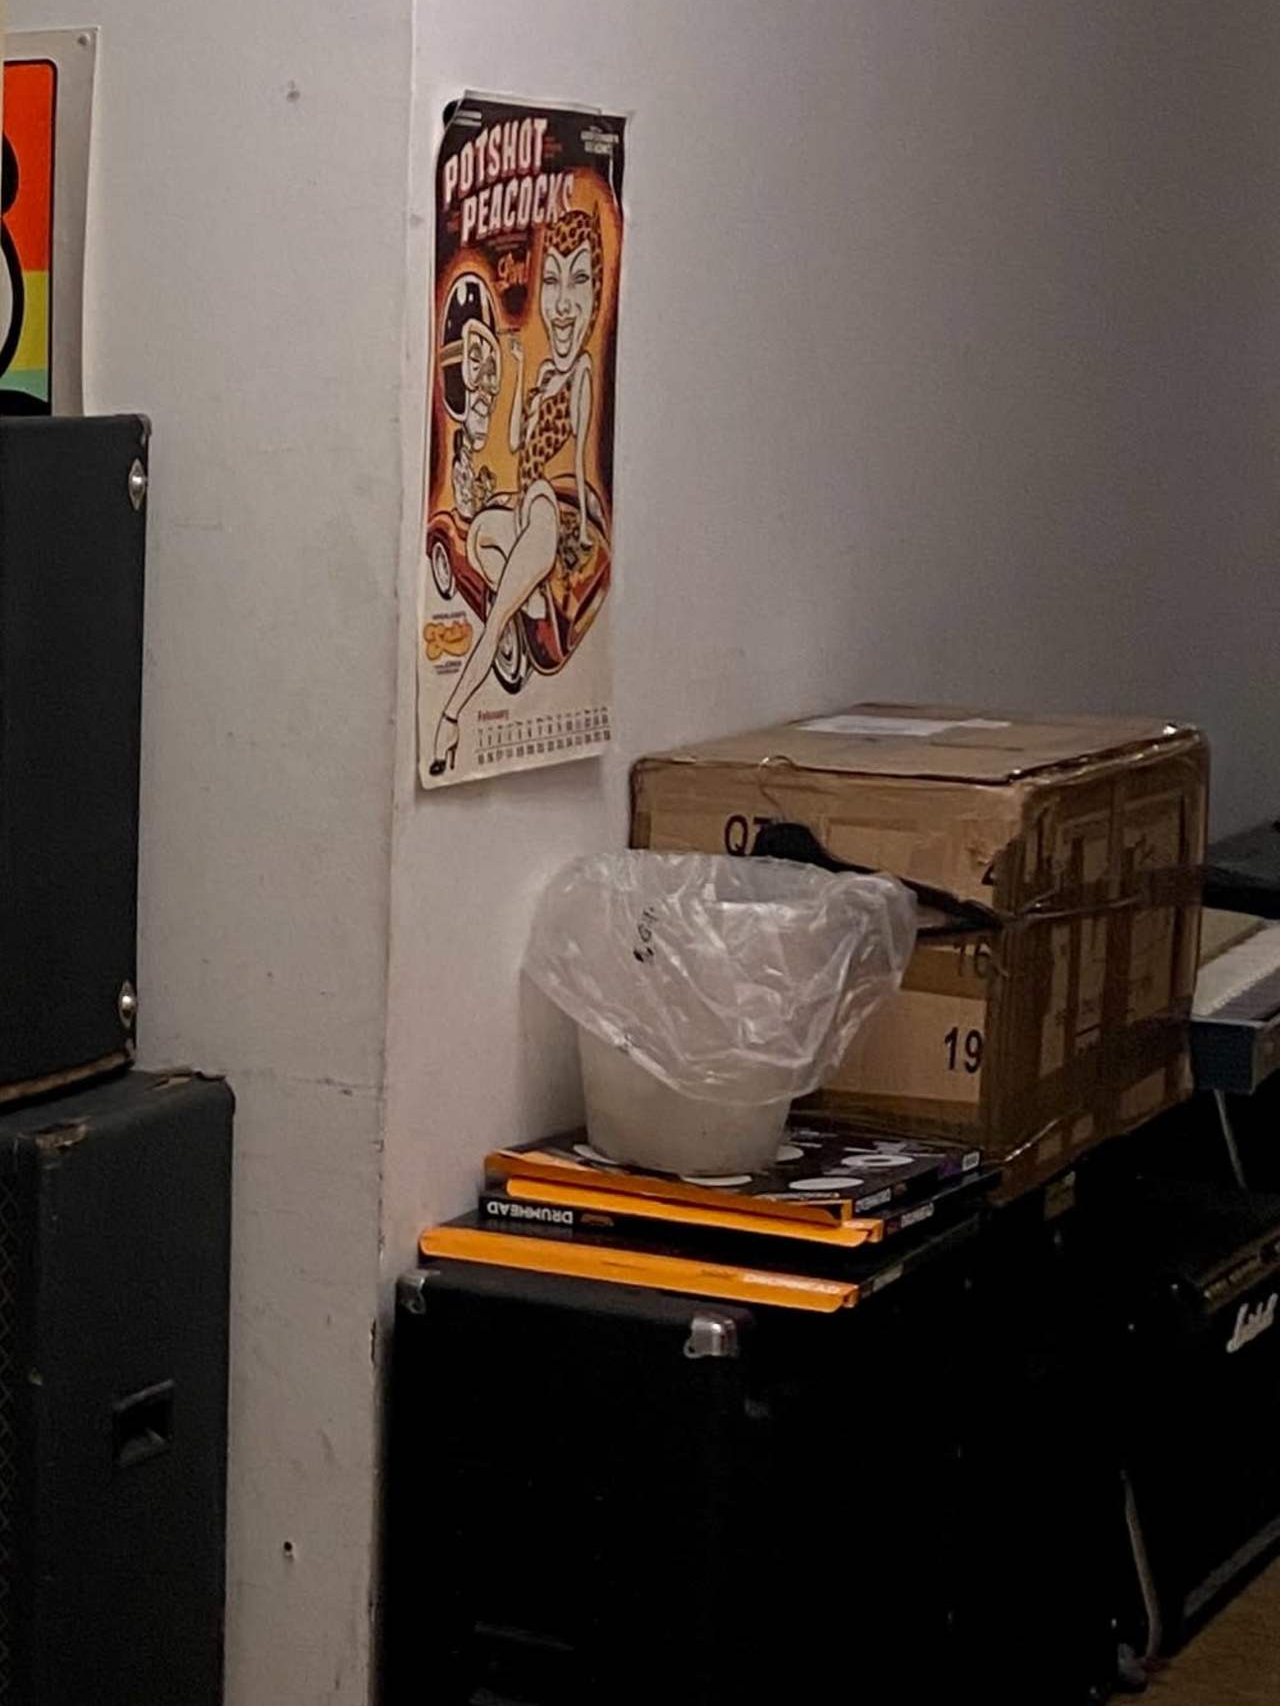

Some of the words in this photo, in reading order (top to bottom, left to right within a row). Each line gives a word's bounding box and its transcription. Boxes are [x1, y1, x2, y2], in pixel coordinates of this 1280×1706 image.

[443, 118, 548, 204] POTSHOT
[462, 173, 574, 243] PEACOCKS
[944, 1027, 983, 1074] 19
[487, 1201, 573, 1225] DRUMHEAD
